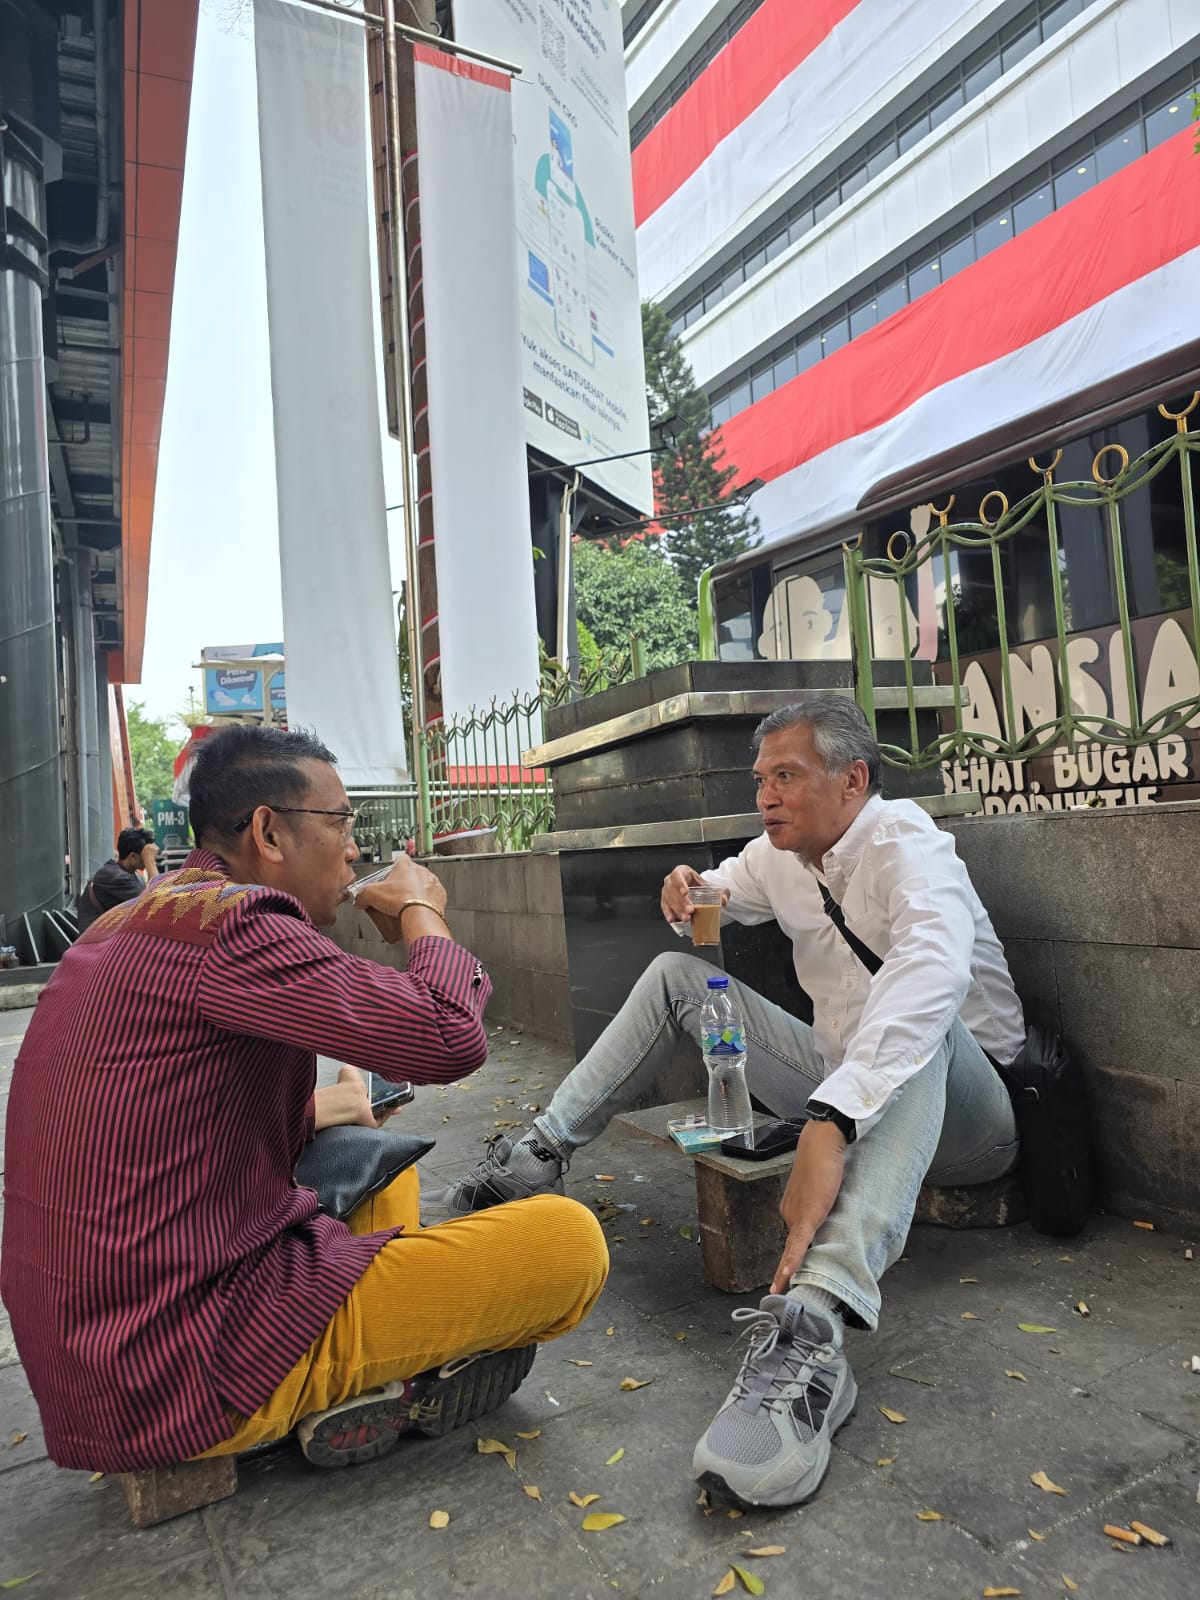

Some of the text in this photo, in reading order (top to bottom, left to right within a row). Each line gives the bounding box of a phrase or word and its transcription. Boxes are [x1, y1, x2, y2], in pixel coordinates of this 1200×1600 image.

[939, 618, 1200, 757] ANSIA
[1053, 734, 1189, 789] BUGAR
[157, 811, 185, 826] PM-3
